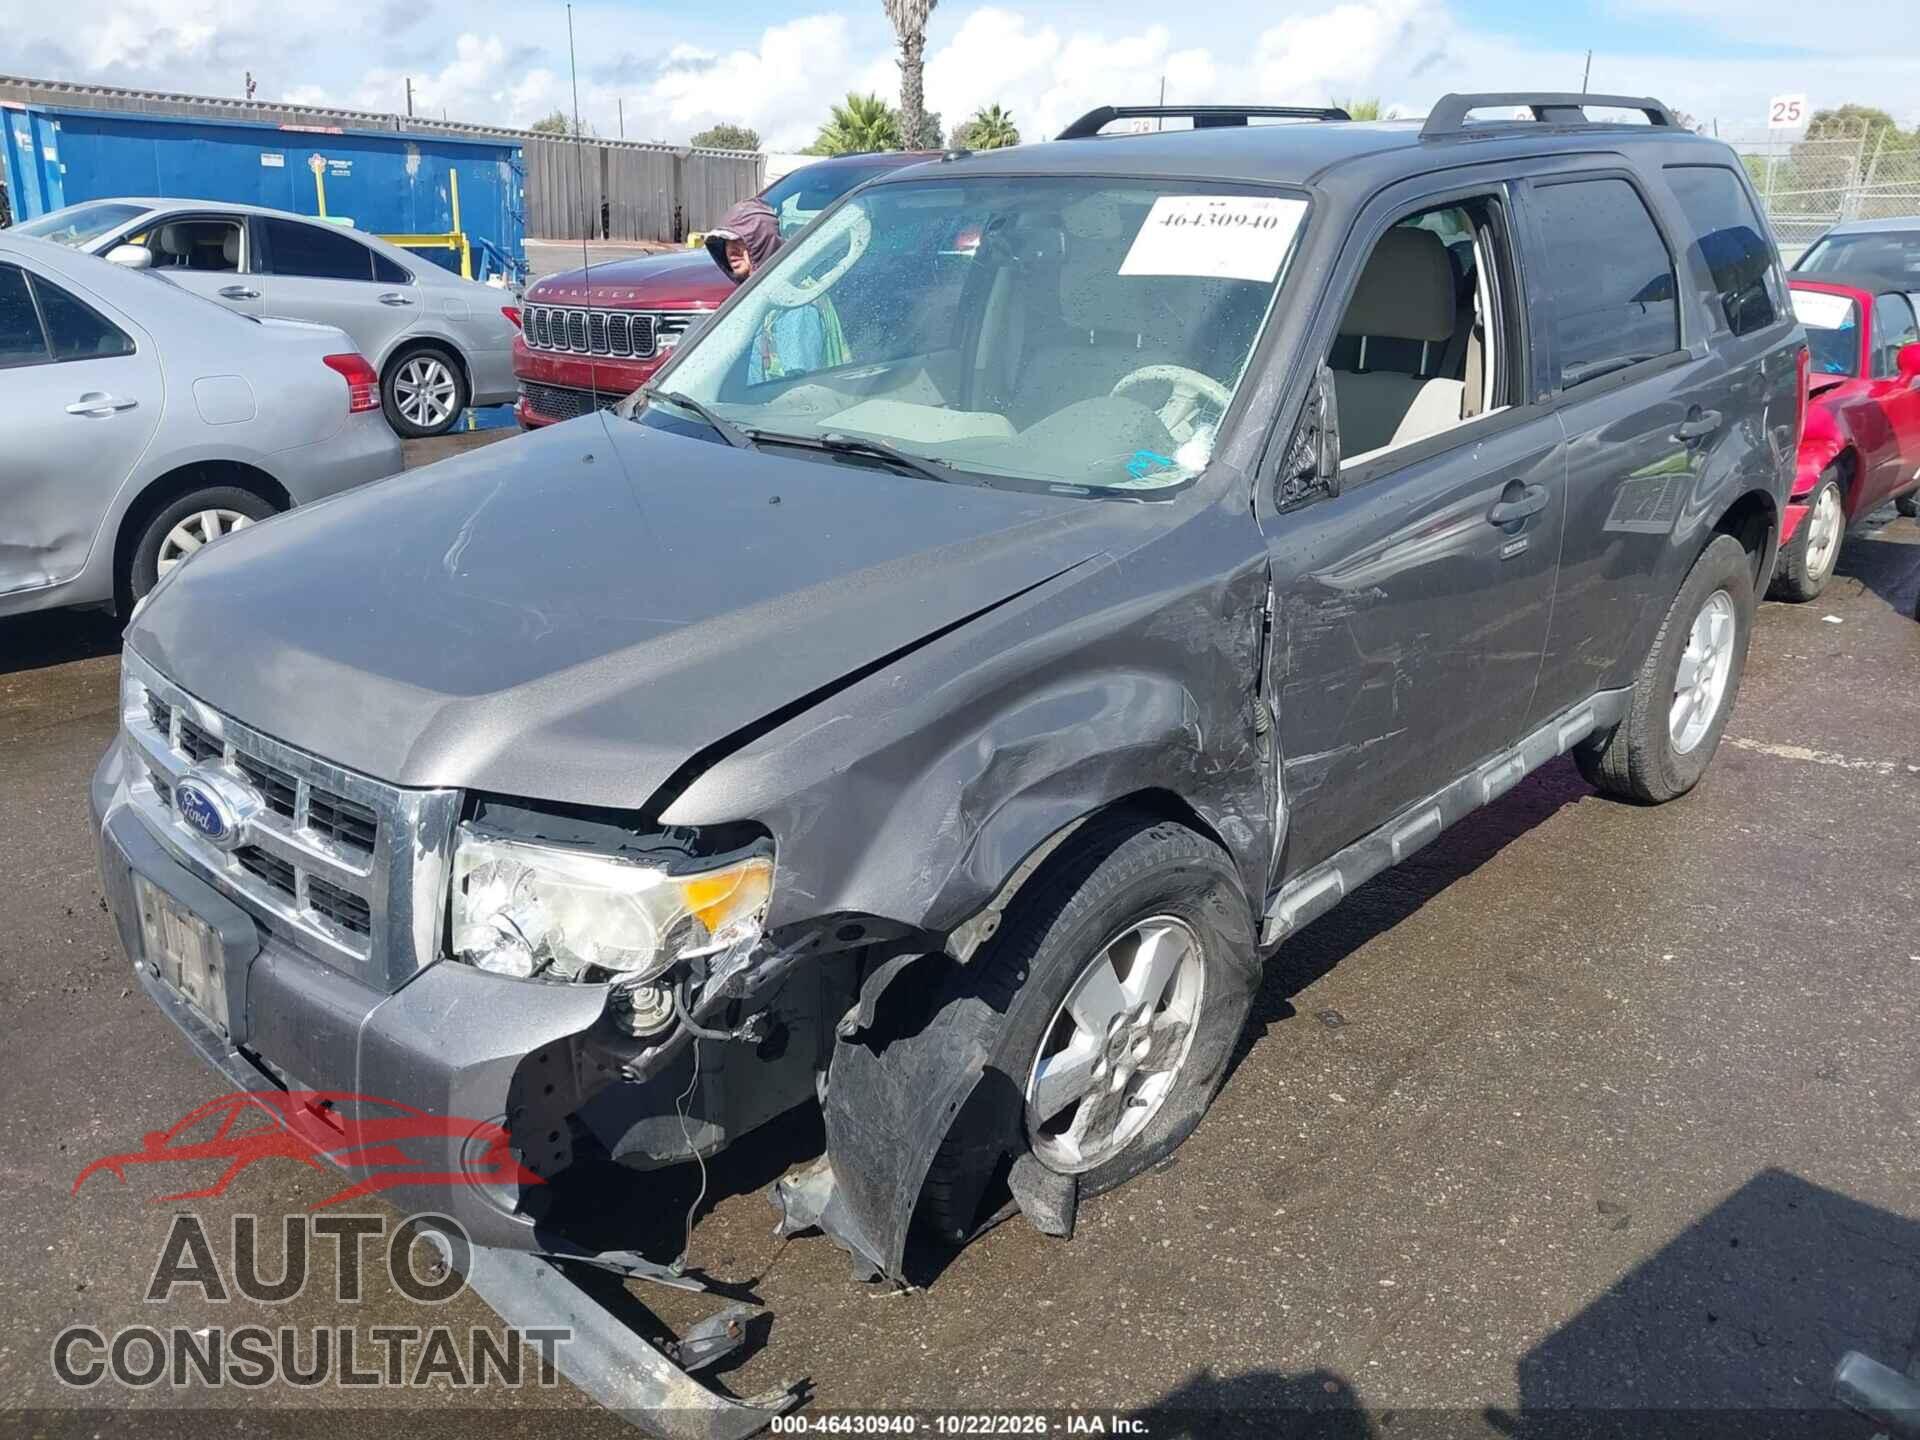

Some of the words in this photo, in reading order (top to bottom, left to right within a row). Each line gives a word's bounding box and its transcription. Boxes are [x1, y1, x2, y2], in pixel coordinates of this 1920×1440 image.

[1772, 101, 1801, 122] 25
[1160, 213, 1278, 230] 46430940
[182, 791, 211, 830] Ford
